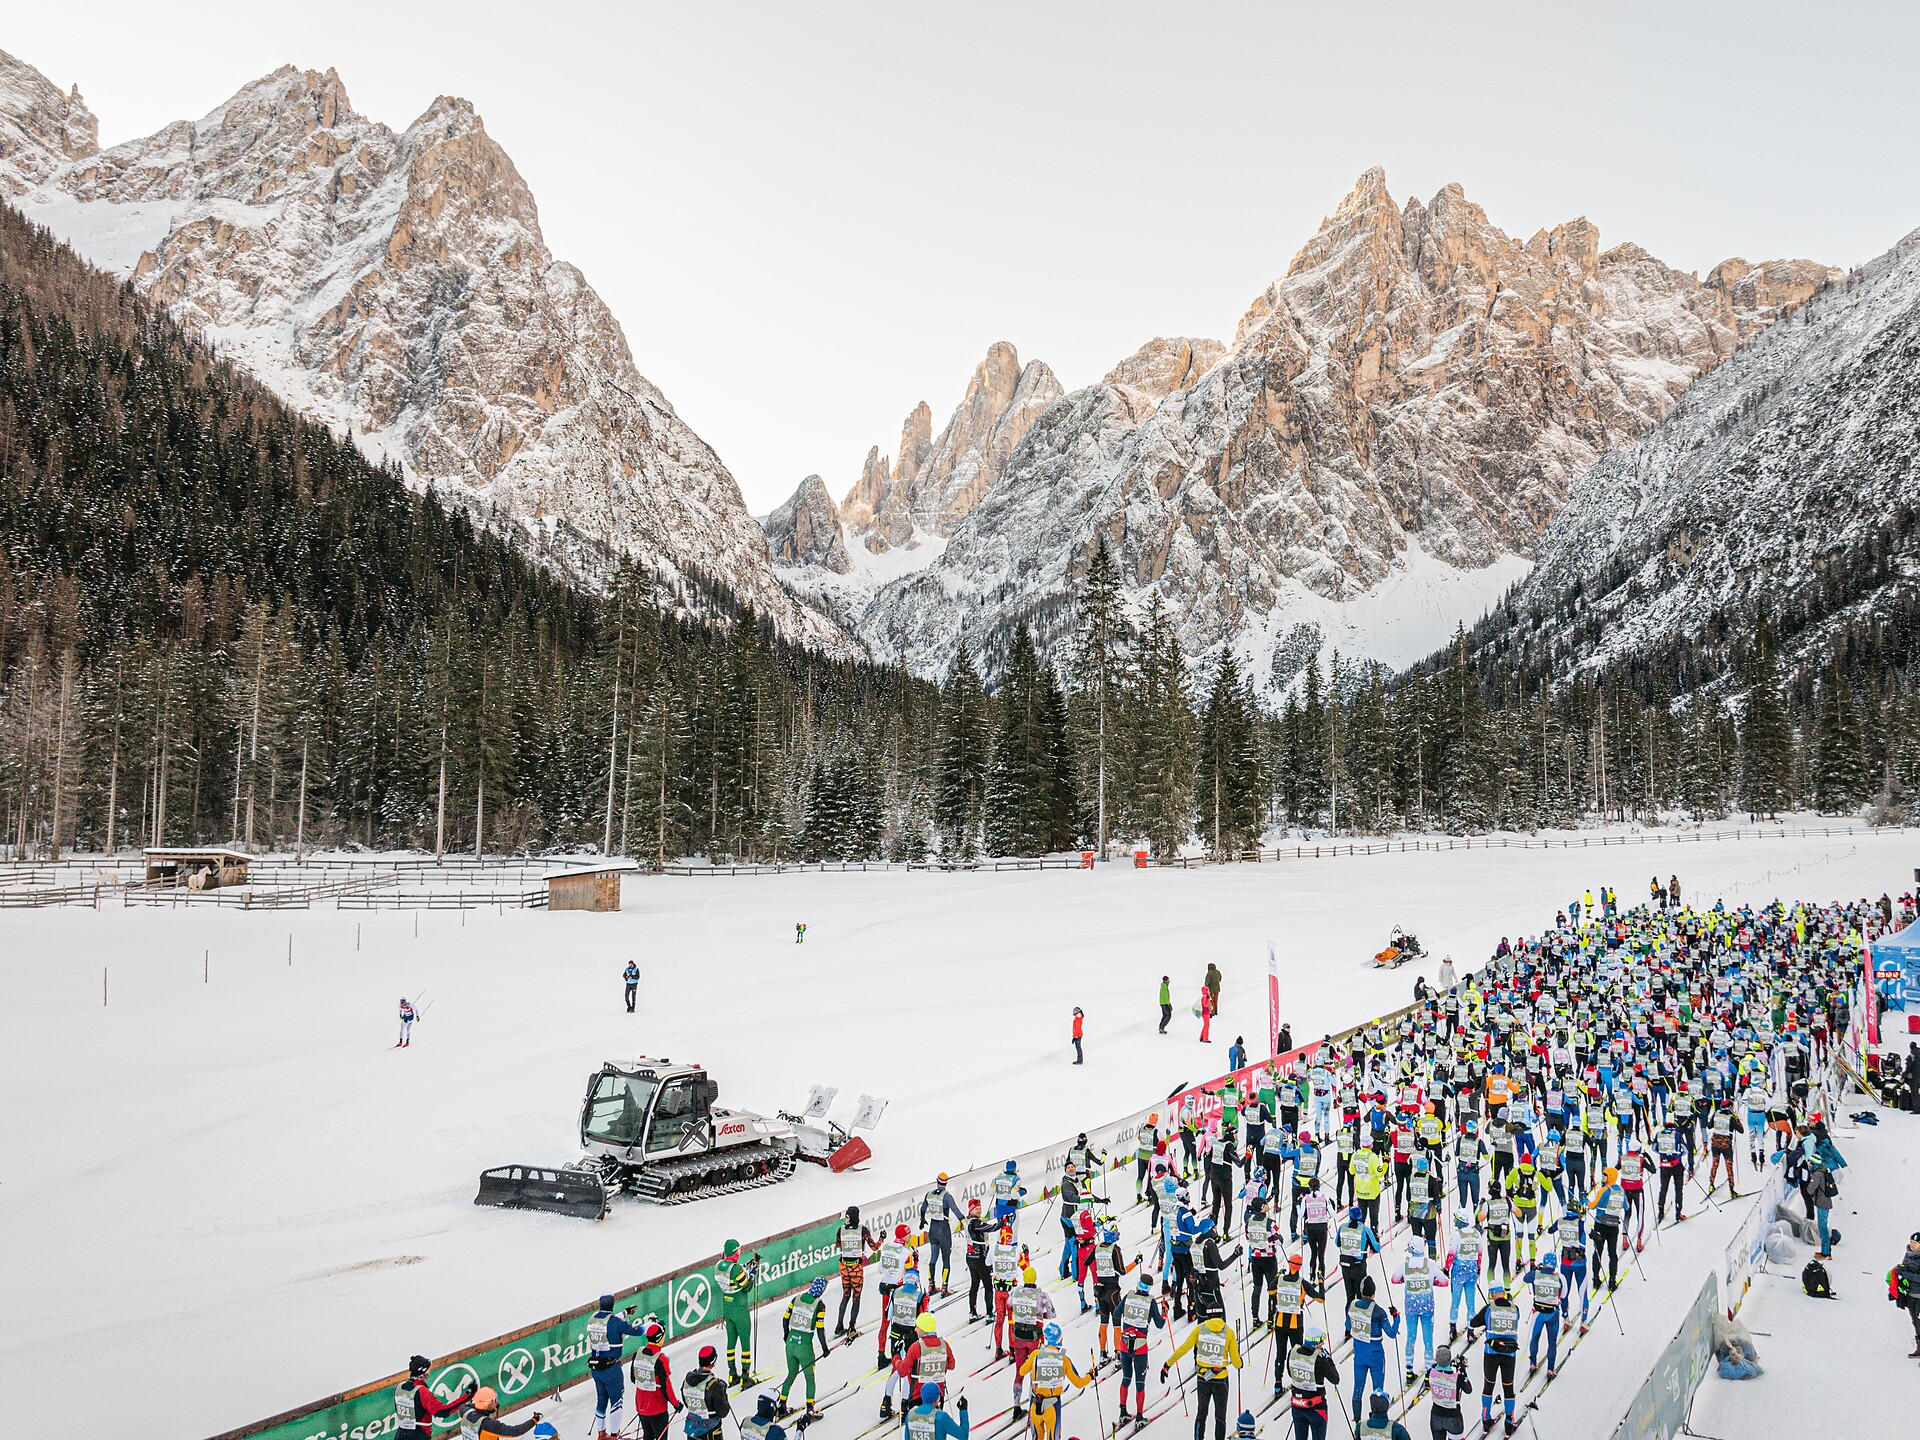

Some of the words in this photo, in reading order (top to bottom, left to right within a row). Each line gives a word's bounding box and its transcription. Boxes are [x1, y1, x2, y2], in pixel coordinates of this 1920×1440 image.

[718, 1123, 746, 1136] Sexten
[1251, 1232, 1264, 1240] 352
[844, 1241, 858, 1249] 382
[1343, 1240, 1357, 1248] 502
[1463, 1243, 1476, 1252] 394
[883, 1257, 896, 1267] 358
[997, 1262, 1013, 1270] 359
[1409, 1280, 1426, 1289] 393
[1281, 1294, 1296, 1303] 411
[896, 1306, 912, 1315] 544
[1016, 1305, 1032, 1315] 534
[1127, 1307, 1145, 1317] 412
[793, 1314, 808, 1326] 354
[1495, 1318, 1513, 1329] 355
[1202, 1344, 1220, 1354] 410
[924, 1362, 941, 1372] 511
[1041, 1367, 1059, 1377] 533
[1293, 1369, 1310, 1380] 329
[687, 1398, 702, 1408] 328
